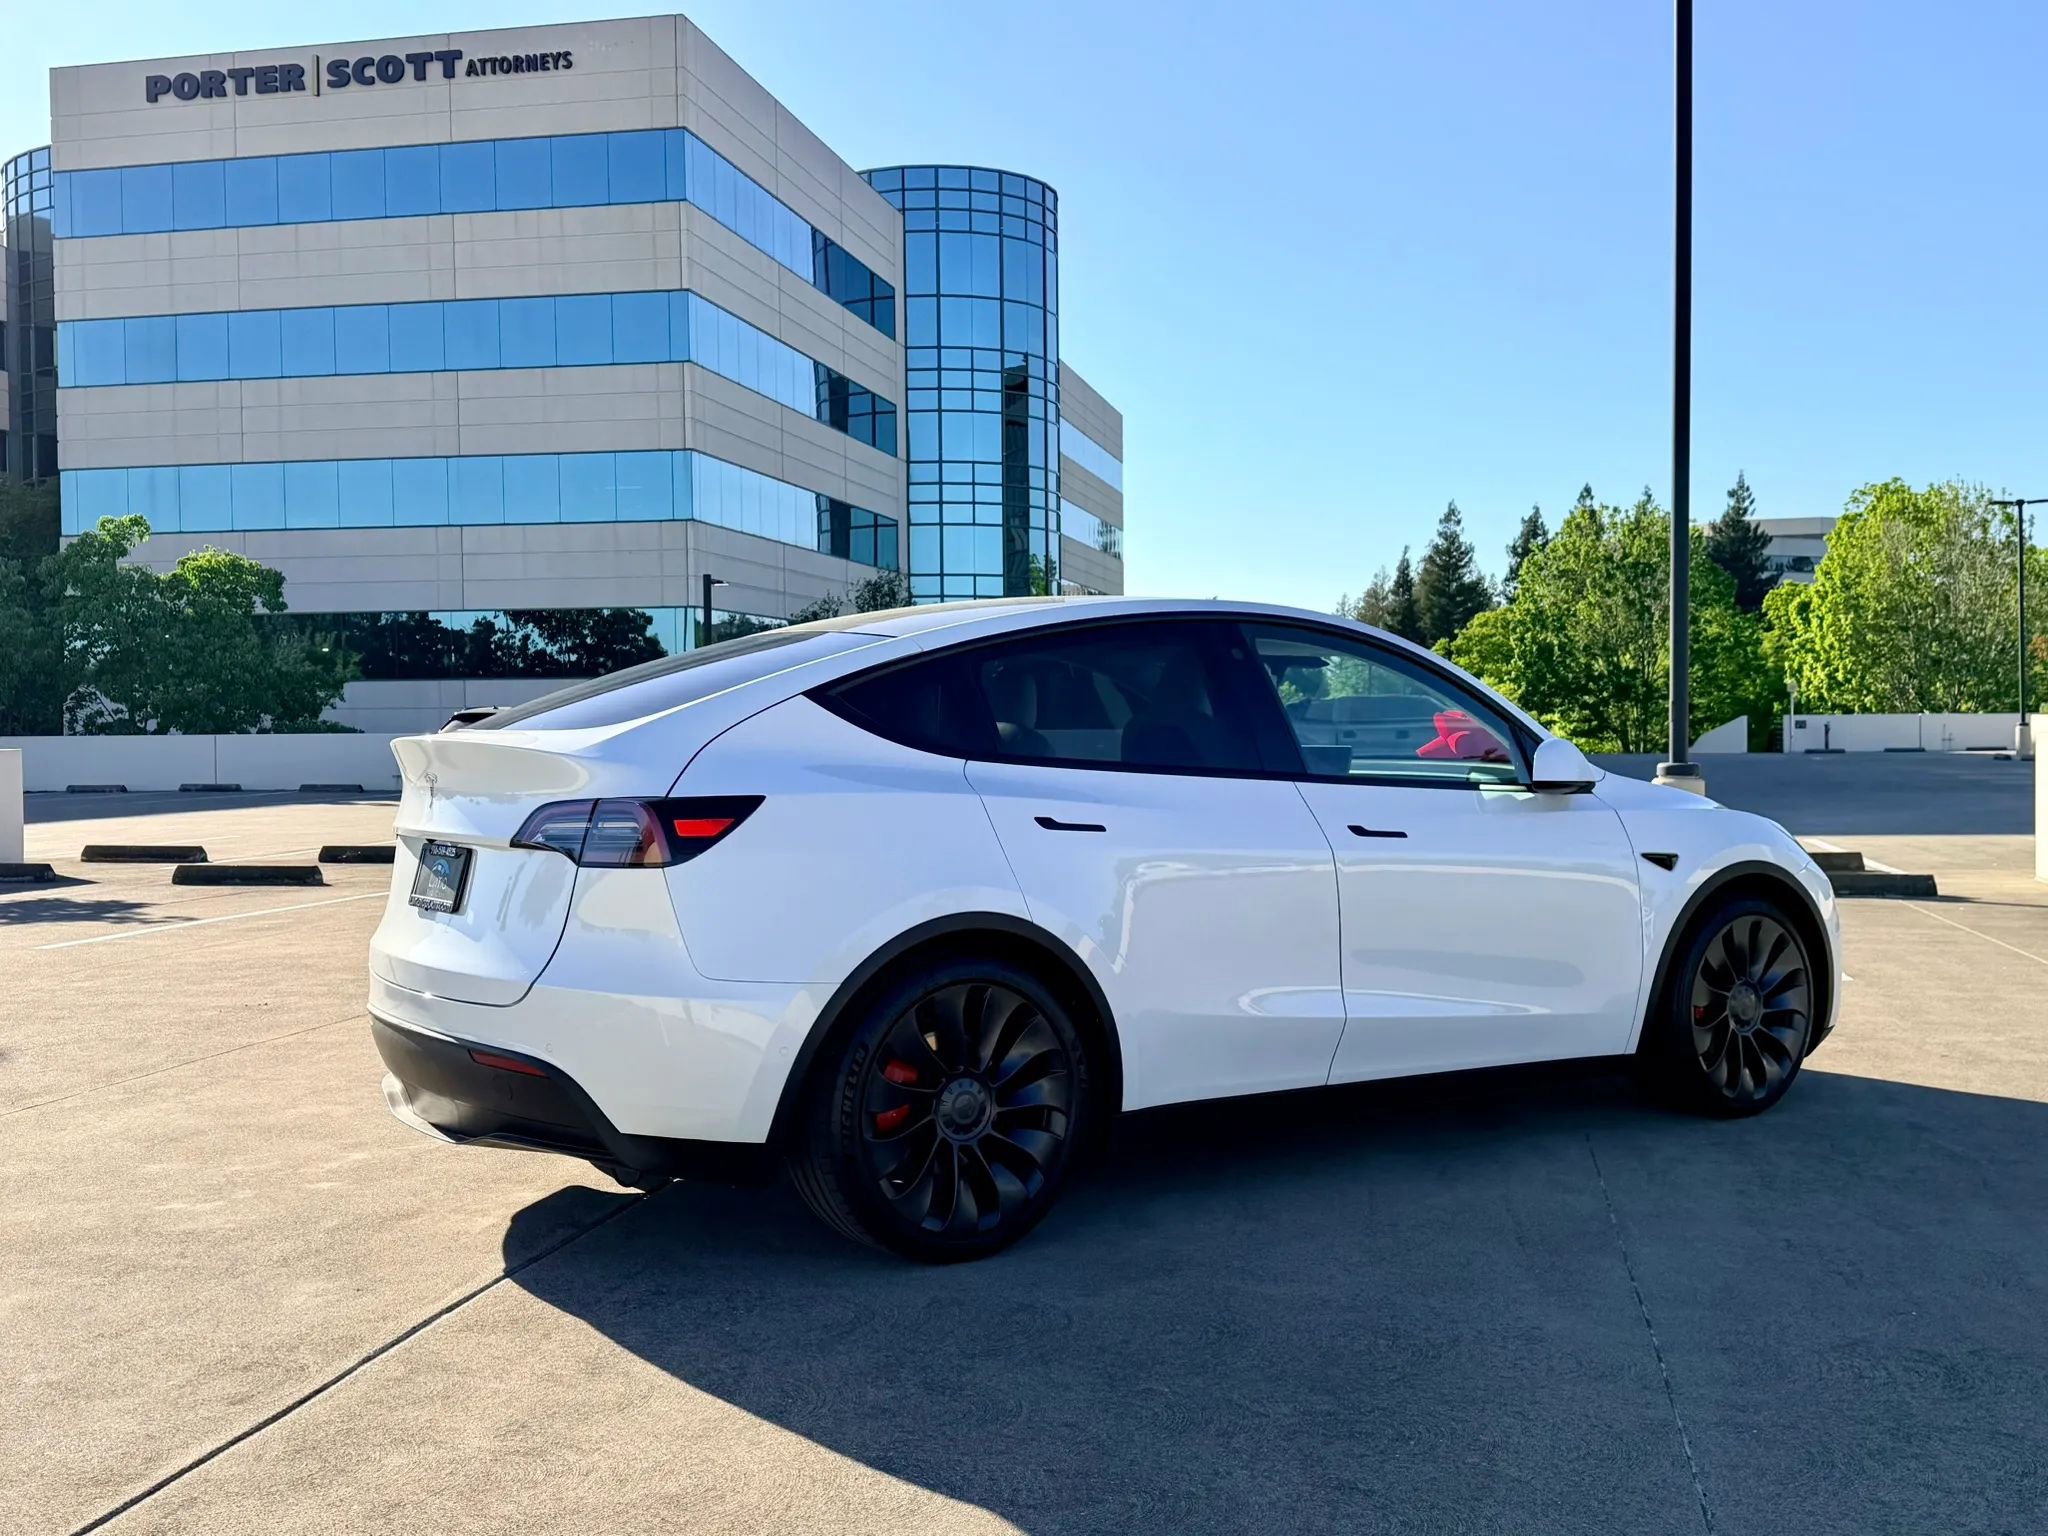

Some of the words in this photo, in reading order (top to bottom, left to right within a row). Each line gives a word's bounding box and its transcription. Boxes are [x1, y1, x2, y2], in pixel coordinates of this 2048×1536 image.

[145, 63, 306, 103] PORTER
[326, 49, 463, 88] SCOTT
[465, 50, 573, 77] ATTORNEYS
[840, 1045, 867, 1148] ICHELIN
